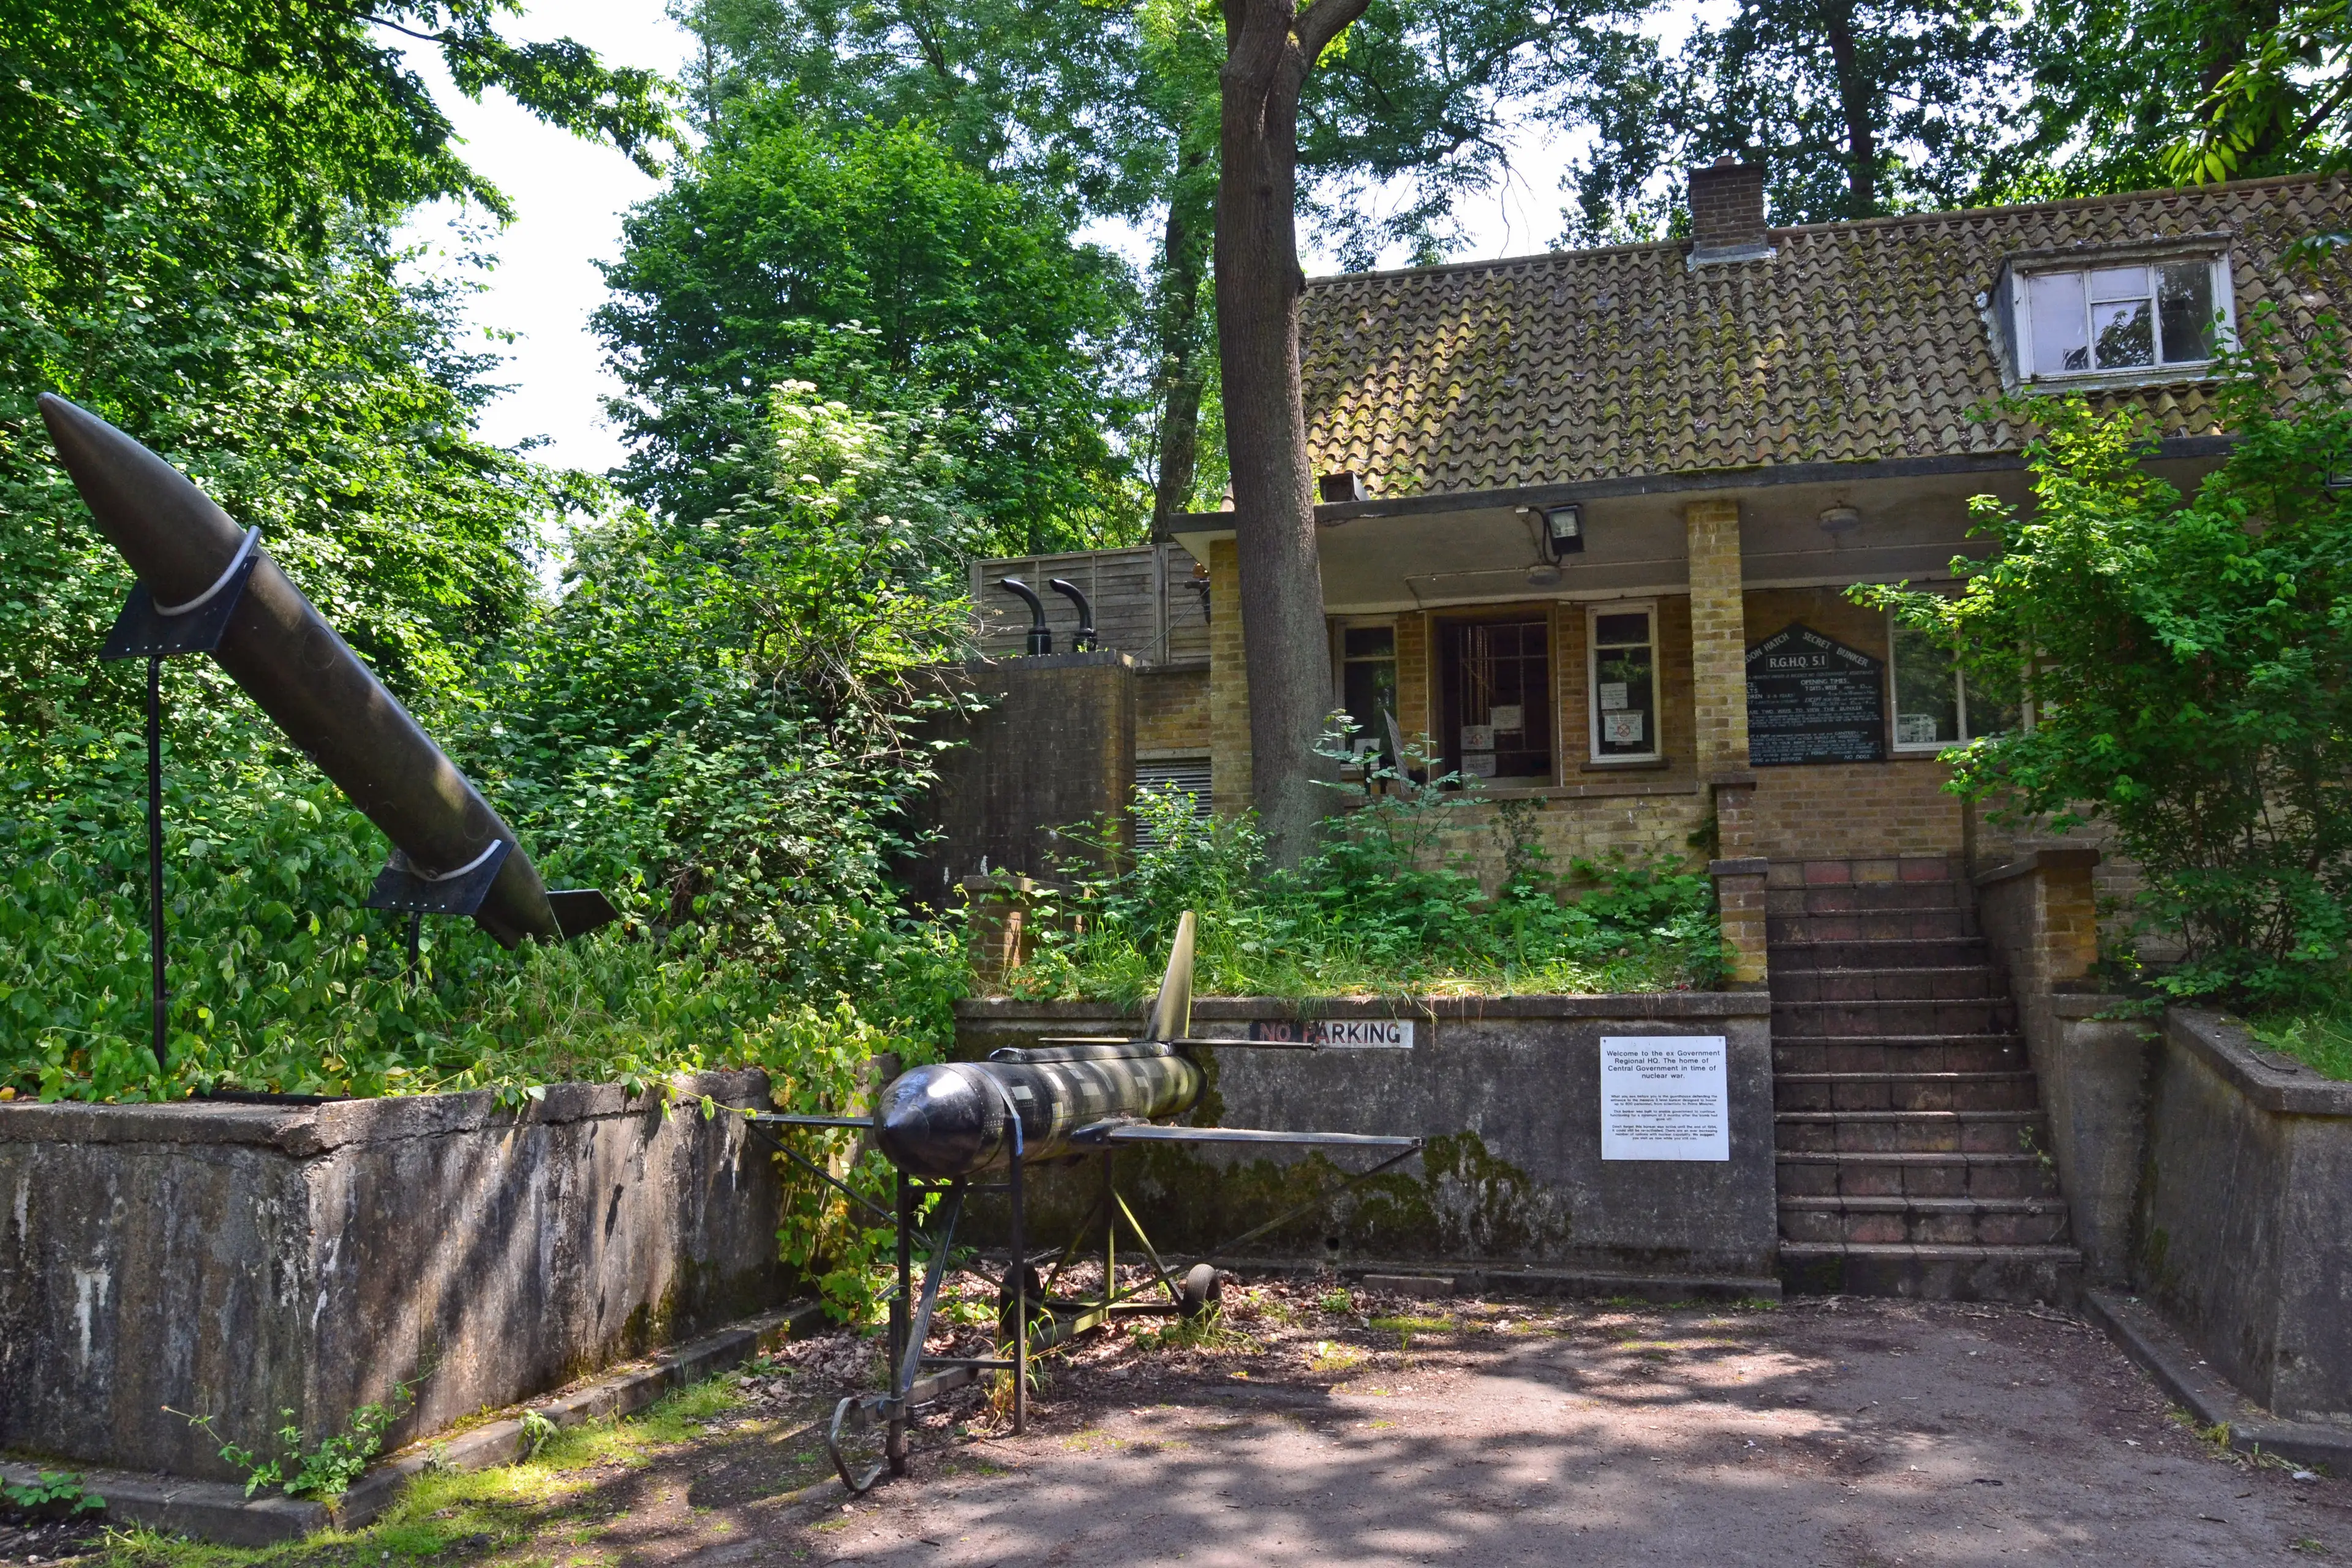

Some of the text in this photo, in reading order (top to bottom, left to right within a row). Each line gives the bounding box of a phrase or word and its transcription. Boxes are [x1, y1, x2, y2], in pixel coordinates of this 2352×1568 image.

[1764, 632, 1789, 652] HATCH
[1803, 632, 1832, 649] SECRET
[1837, 647, 1868, 667] BUNKER
[1770, 656, 1808, 668] R.G.H.Q.
[1259, 1022, 1400, 1044] NO PARKING
